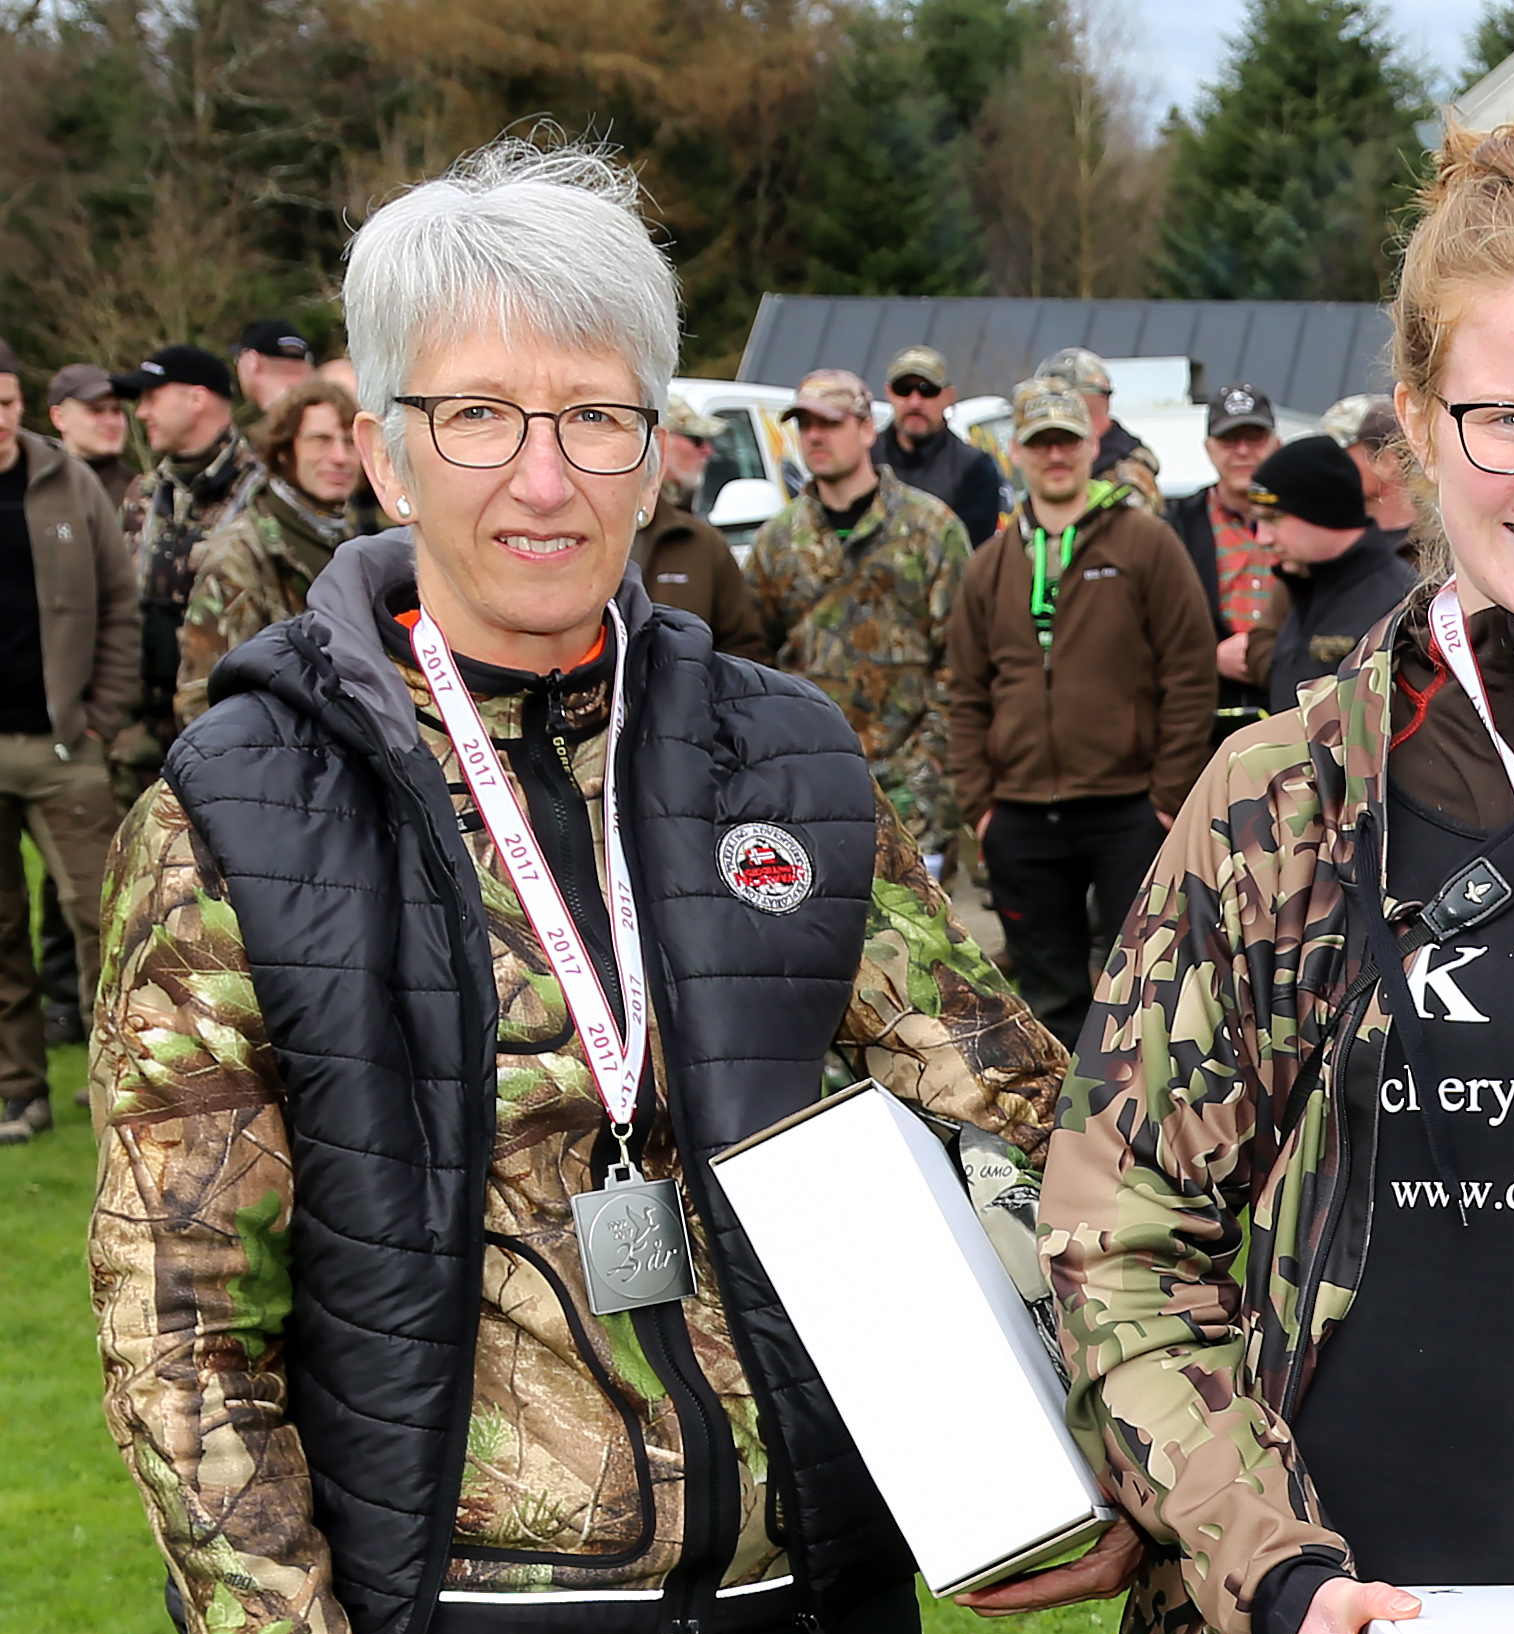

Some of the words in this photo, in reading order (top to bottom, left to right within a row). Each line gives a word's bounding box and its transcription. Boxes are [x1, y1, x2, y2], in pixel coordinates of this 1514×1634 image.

[1447, 613, 1462, 653] 2017
[422, 645, 454, 693] 2017
[462, 738, 497, 787] 2017
[504, 833, 540, 881] 2017
[547, 927, 583, 976] 2017
[587, 1022, 619, 1073] 2017
[617, 880, 635, 931] 2017
[629, 974, 645, 1026] 2017
[979, 1165, 1013, 1179] CAMO
[646, 1239, 678, 1272] år
